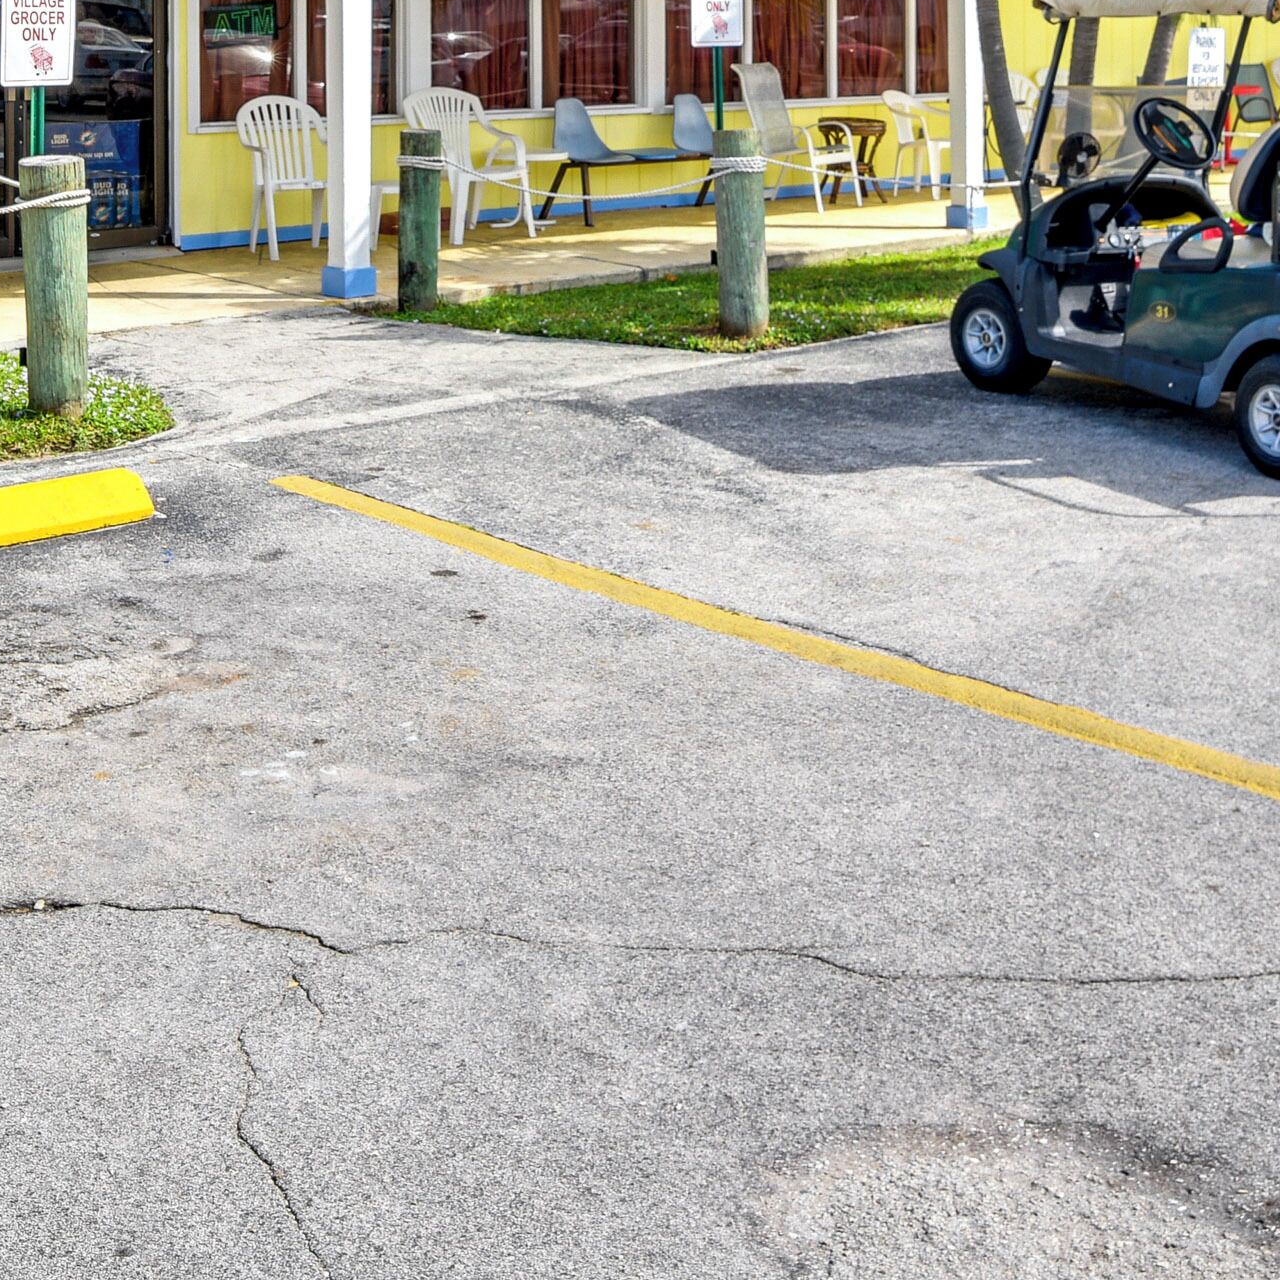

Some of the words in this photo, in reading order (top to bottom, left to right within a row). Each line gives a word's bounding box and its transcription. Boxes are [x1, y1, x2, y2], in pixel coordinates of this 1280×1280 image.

[706, 1, 730, 12] ONLY
[10, 11, 65, 25] GROCER
[212, 6, 275, 41] ATM
[22, 27, 56, 41] ONLY
[1156, 305, 1168, 319] 31
